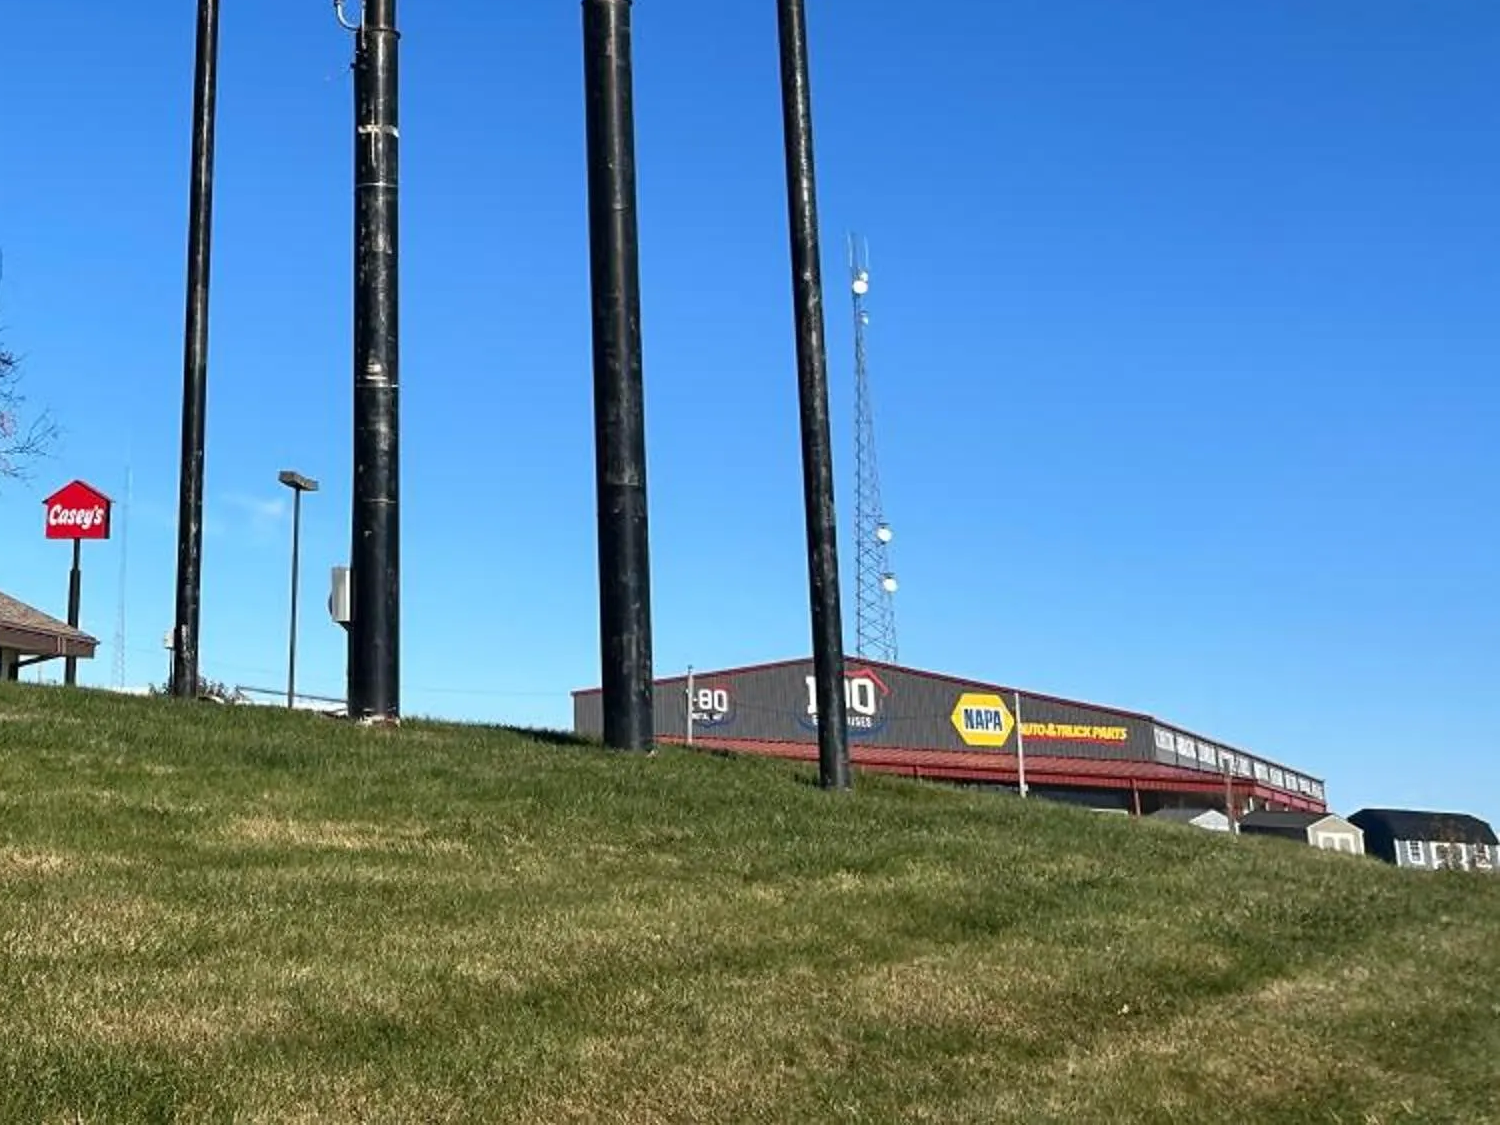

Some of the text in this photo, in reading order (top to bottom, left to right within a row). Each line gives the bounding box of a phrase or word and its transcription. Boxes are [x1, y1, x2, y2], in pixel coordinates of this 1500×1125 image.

[49, 503, 104, 530] Casey's
[963, 708, 1003, 732] NAPA
[1056, 724, 1092, 739] TRUCK
[1092, 726, 1128, 740] PARTS
